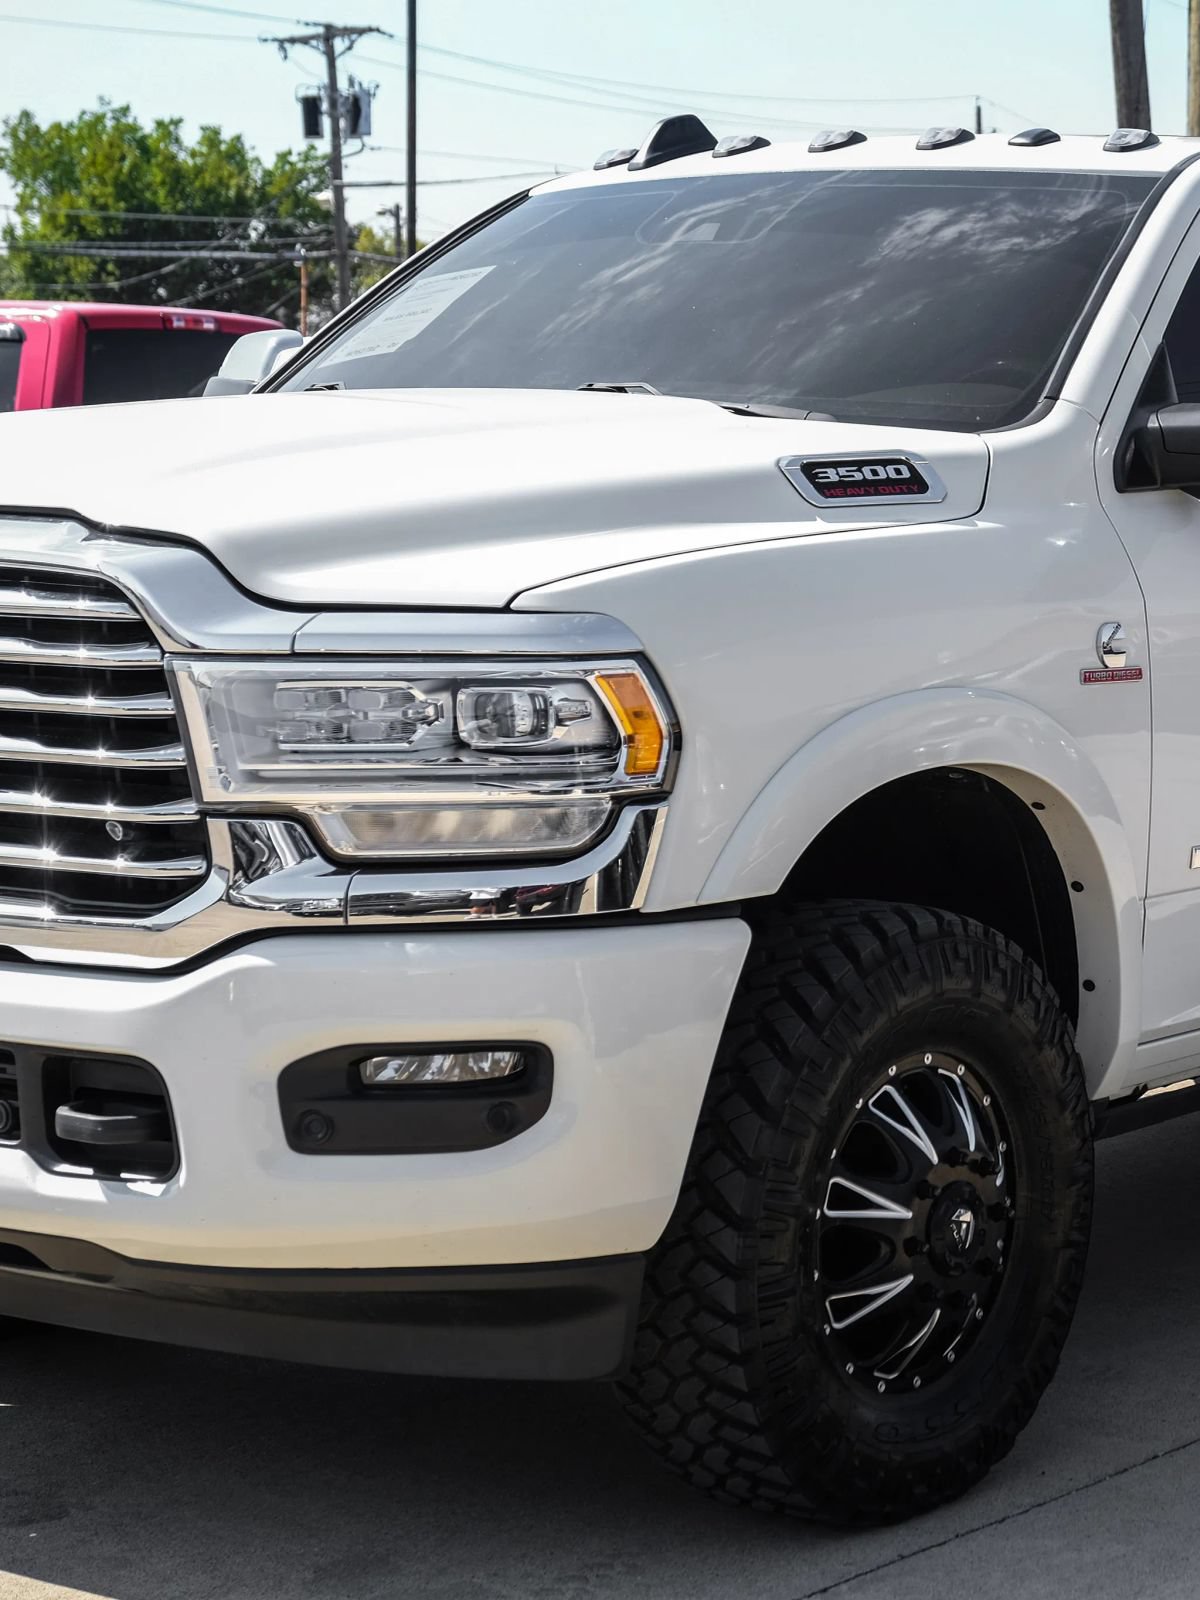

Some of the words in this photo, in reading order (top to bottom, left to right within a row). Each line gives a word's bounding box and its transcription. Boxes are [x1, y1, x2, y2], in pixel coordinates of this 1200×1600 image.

[812, 465, 911, 482] 3500
[824, 486, 875, 496] HEAVY
[878, 484, 919, 494] DUTY
